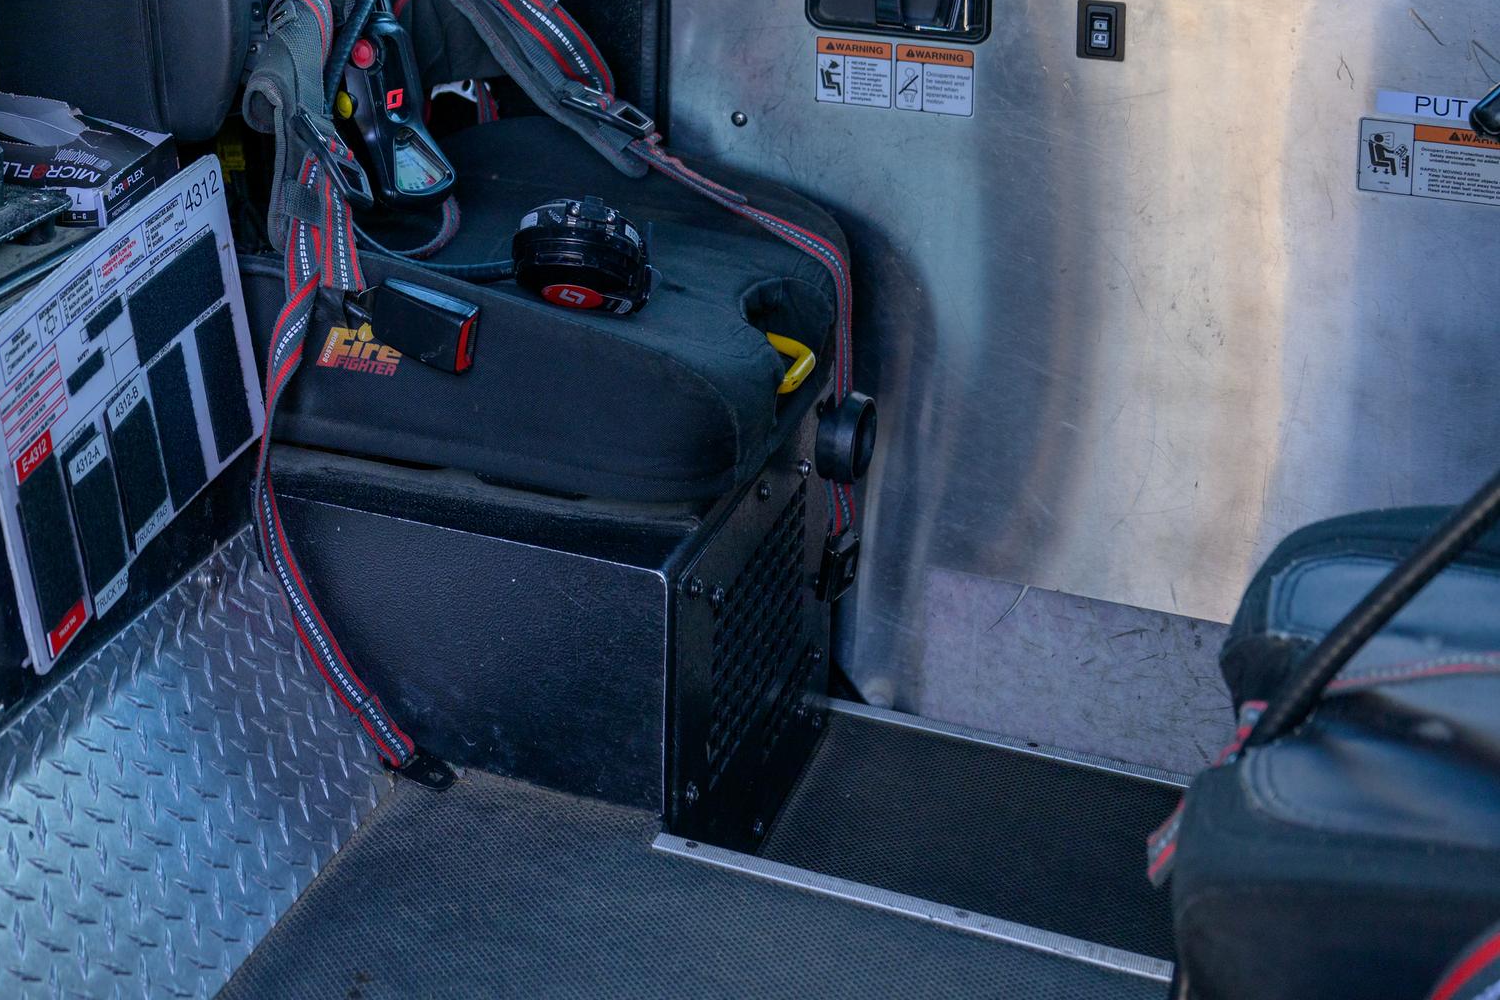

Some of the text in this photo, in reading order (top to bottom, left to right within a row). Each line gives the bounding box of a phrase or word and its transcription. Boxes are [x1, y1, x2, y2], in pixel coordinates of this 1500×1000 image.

[835, 43, 884, 55] WARNING
[915, 50, 964, 62] WARNING
[1415, 96, 1468, 117] PUT
[185, 170, 219, 212] 4312
[316, 324, 403, 368] Fire
[322, 331, 339, 363] BOSTROM
[335, 357, 397, 377] FIGHTER
[115, 386, 139, 418] 4312-B
[21, 438, 47, 473] E-4312
[75, 445, 101, 474] 4312-A
[136, 505, 168, 545] TRUCK TAG
[97, 573, 128, 610] TRUCK TAG
